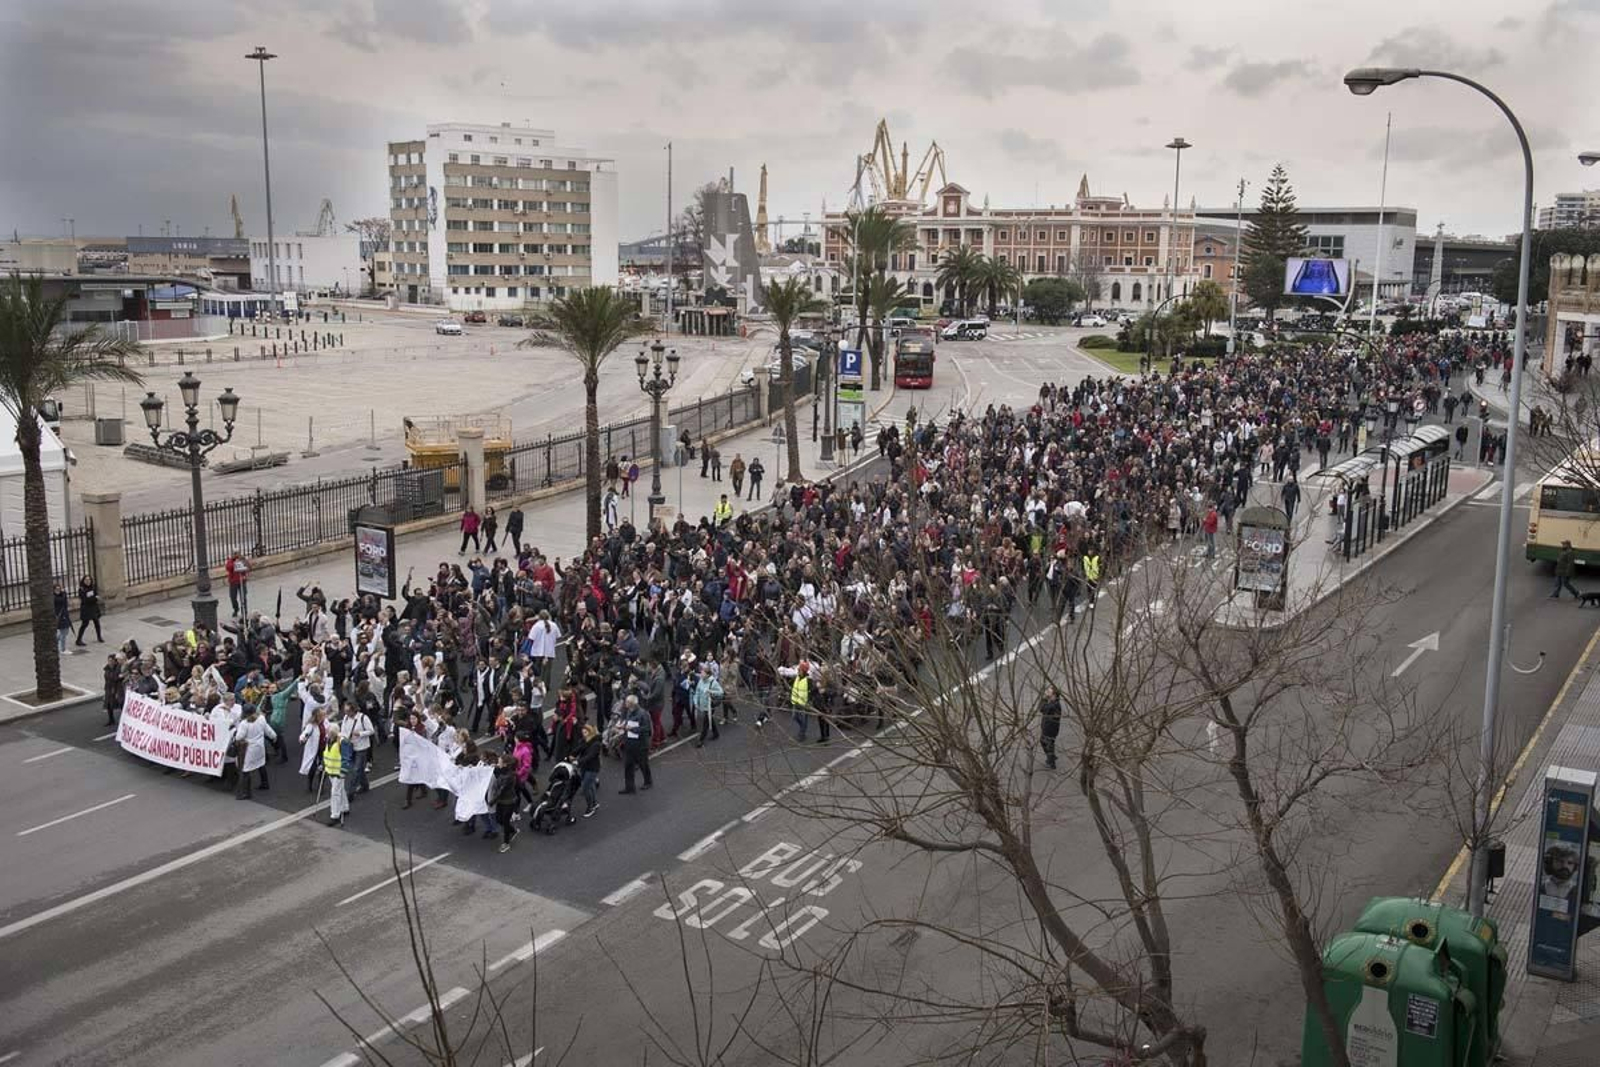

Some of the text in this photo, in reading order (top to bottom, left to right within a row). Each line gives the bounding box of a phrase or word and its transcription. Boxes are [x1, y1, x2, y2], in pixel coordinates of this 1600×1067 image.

[846, 353, 857, 369] P
[359, 543, 387, 557] FORD
[1244, 539, 1282, 554] FORD
[201, 722, 215, 742] EN
[148, 737, 181, 763] SANIDAD
[737, 842, 863, 897] BUS
[653, 879, 829, 950] SOLO
